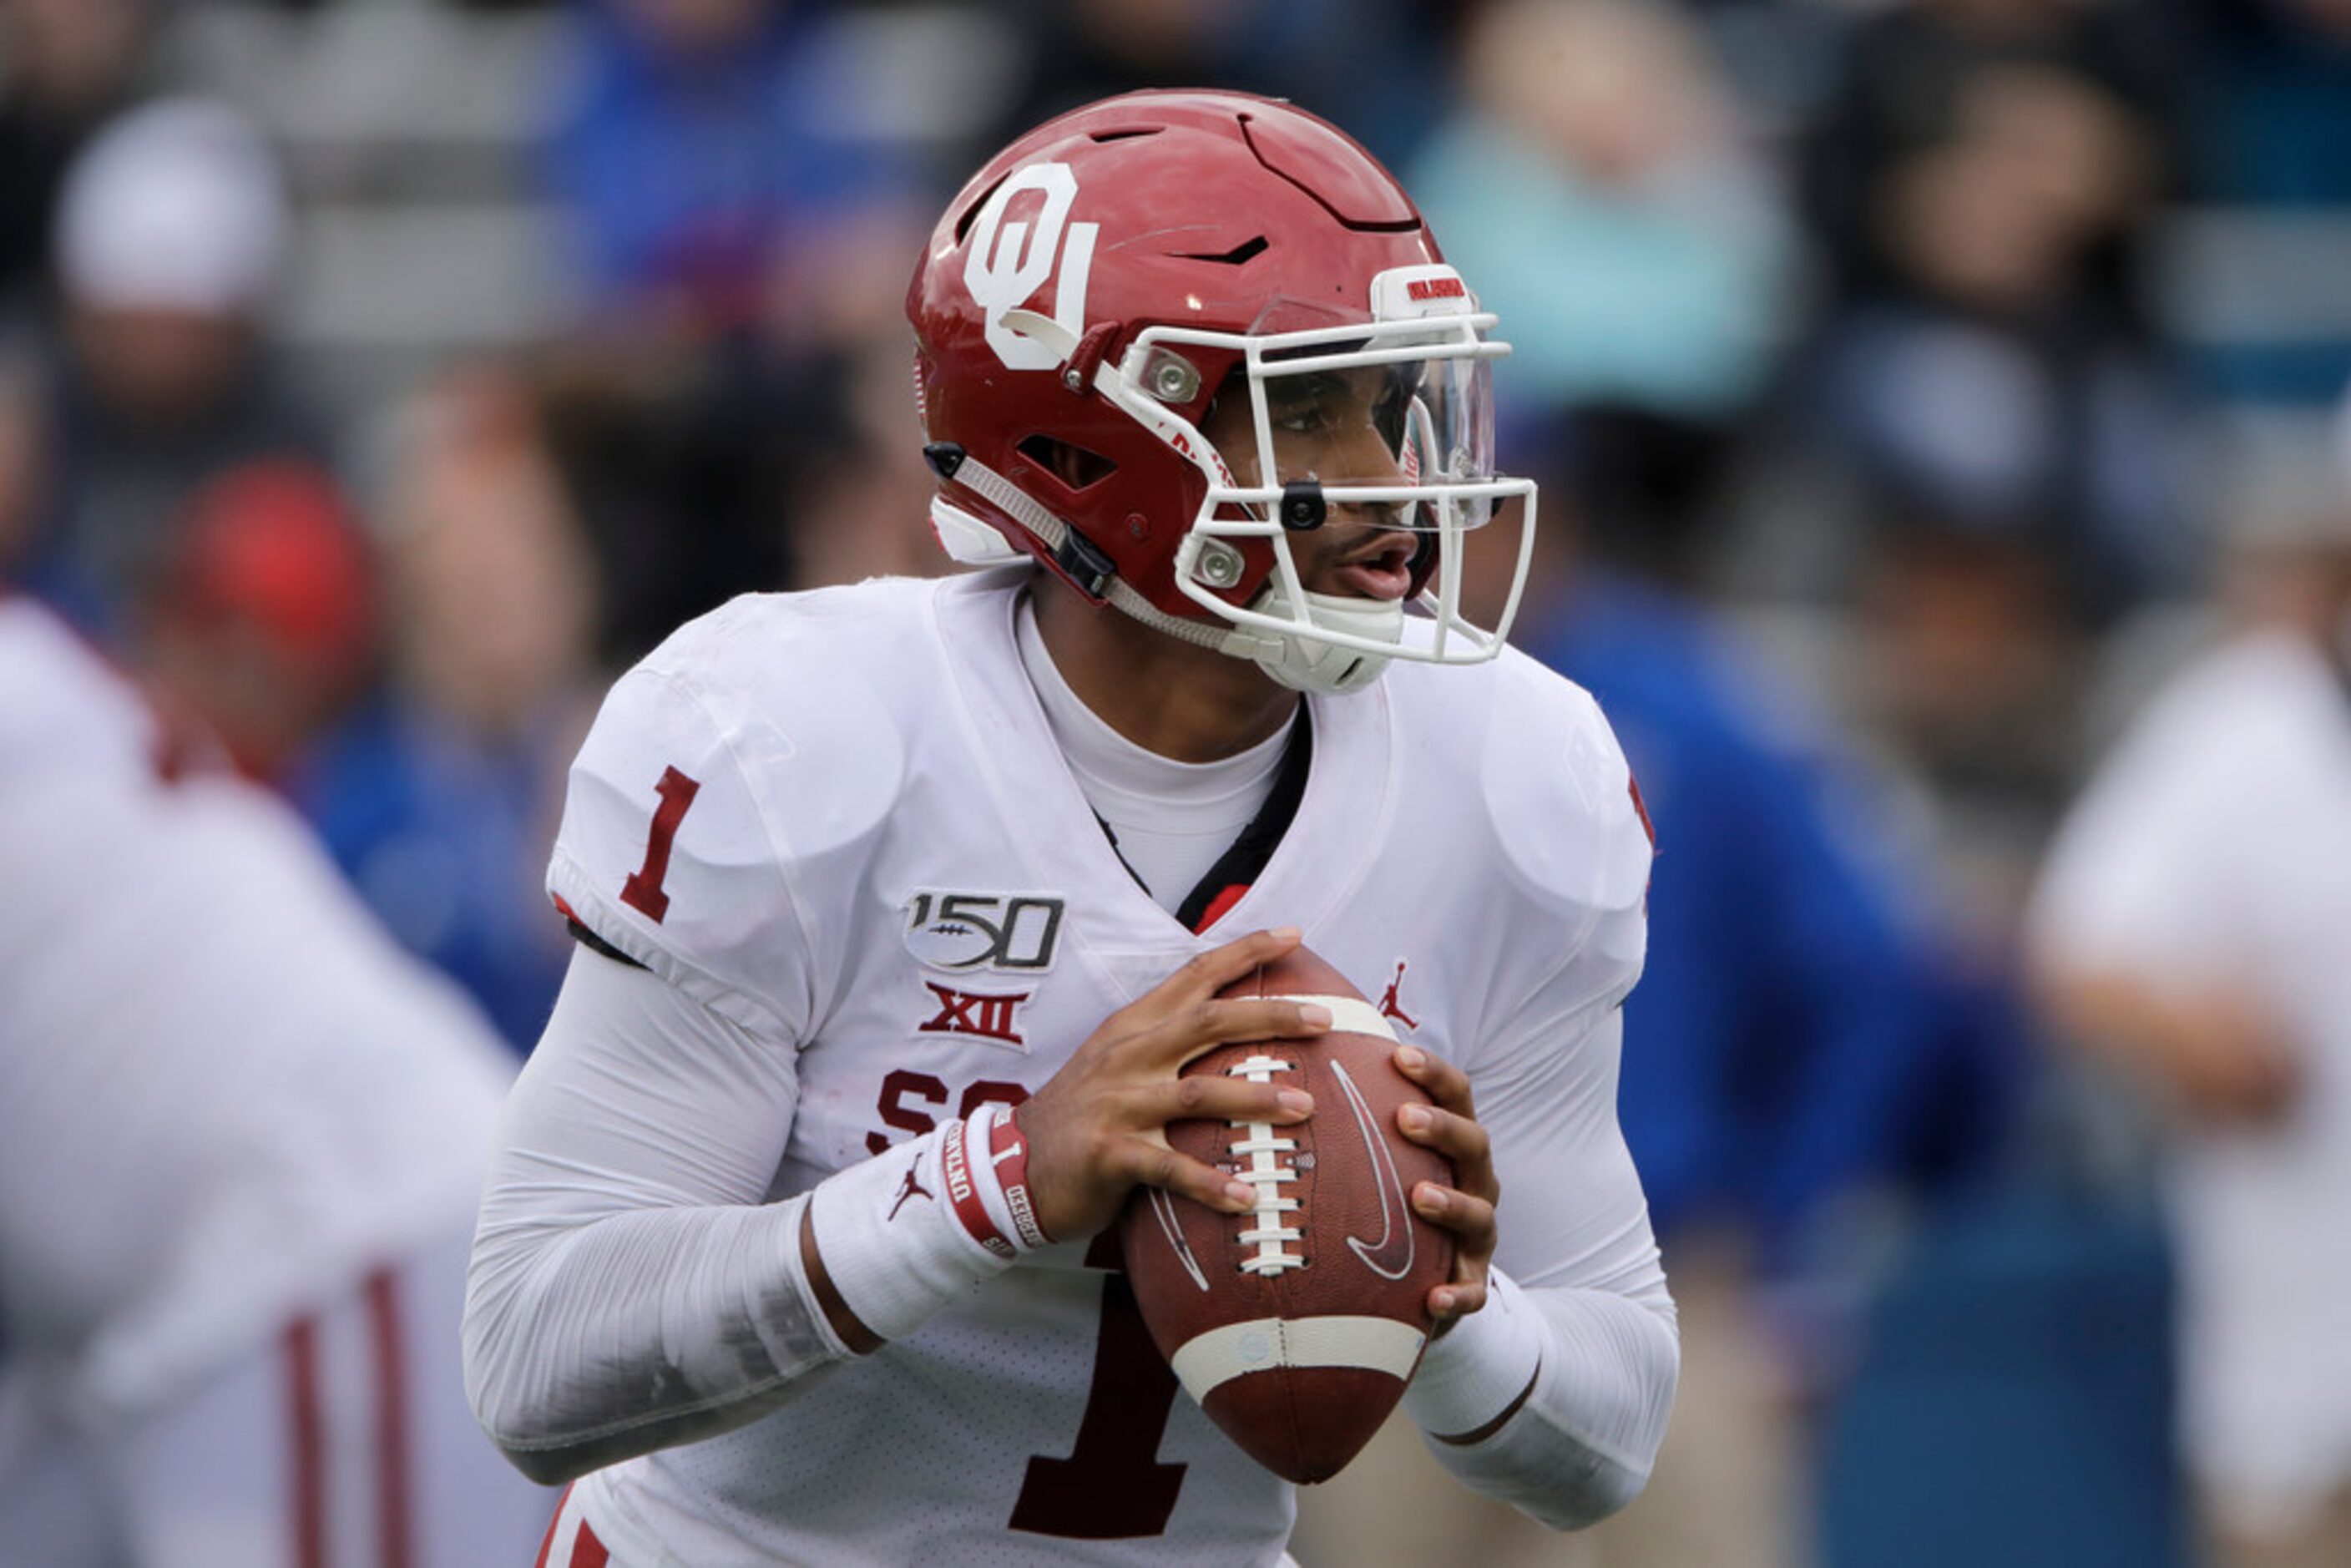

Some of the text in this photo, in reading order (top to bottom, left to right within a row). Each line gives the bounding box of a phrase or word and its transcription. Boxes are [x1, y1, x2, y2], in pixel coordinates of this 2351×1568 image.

[963, 163, 1100, 370] OU
[619, 764, 701, 925] 1
[913, 893, 1065, 968] 150
[918, 980, 1030, 1045] XII
[1008, 1222, 1189, 1540] 1
